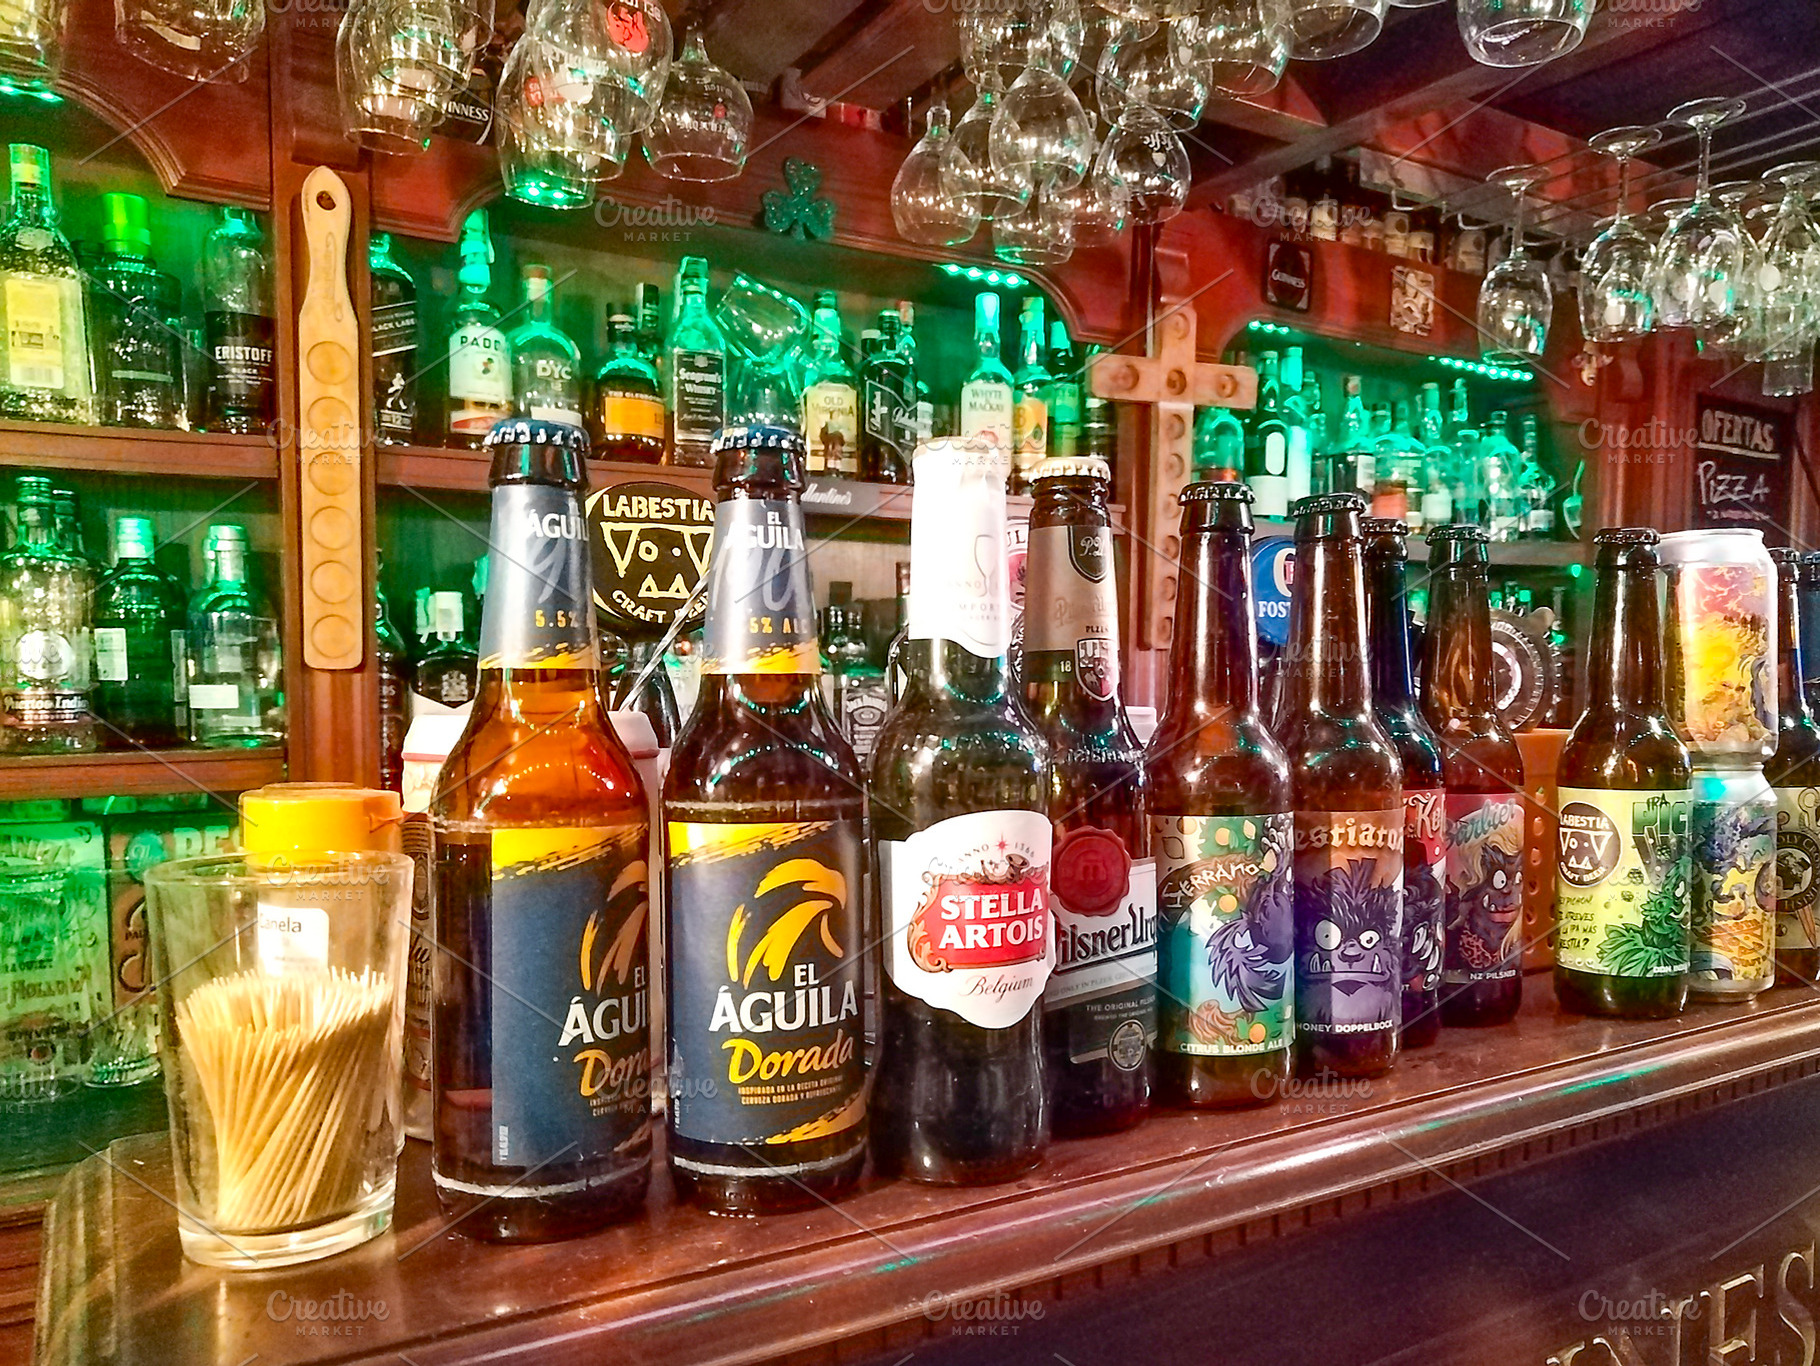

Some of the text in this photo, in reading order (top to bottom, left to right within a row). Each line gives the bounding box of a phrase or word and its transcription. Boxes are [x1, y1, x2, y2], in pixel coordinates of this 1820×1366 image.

[448, 101, 490, 122] INNESS
[215, 346, 272, 362] ERISTOFF
[537, 360, 572, 379] DYC
[824, 396, 844, 405] OLD
[1702, 409, 1774, 452] OFERTAS
[603, 495, 714, 522] LABESTIA
[767, 510, 782, 525] EL
[528, 509, 590, 541] ÁGUIL
[611, 590, 666, 624] CRAFT
[1060, 661, 1071, 672] 18
[940, 887, 1043, 920] STELLA
[938, 915, 1043, 949] ARTOIS
[794, 963, 820, 987] EL
[1486, 969, 1516, 980] PILSNER
[959, 975, 1033, 1004] Belgium
[708, 980, 858, 1033] ÁGUILA
[557, 996, 647, 1047] ÁGUI
[1334, 1019, 1393, 1033] DOPPELBOCK
[721, 1028, 854, 1084] Dorada
[1180, 1039, 1283, 1054] CITRUS BLONDE ALE
